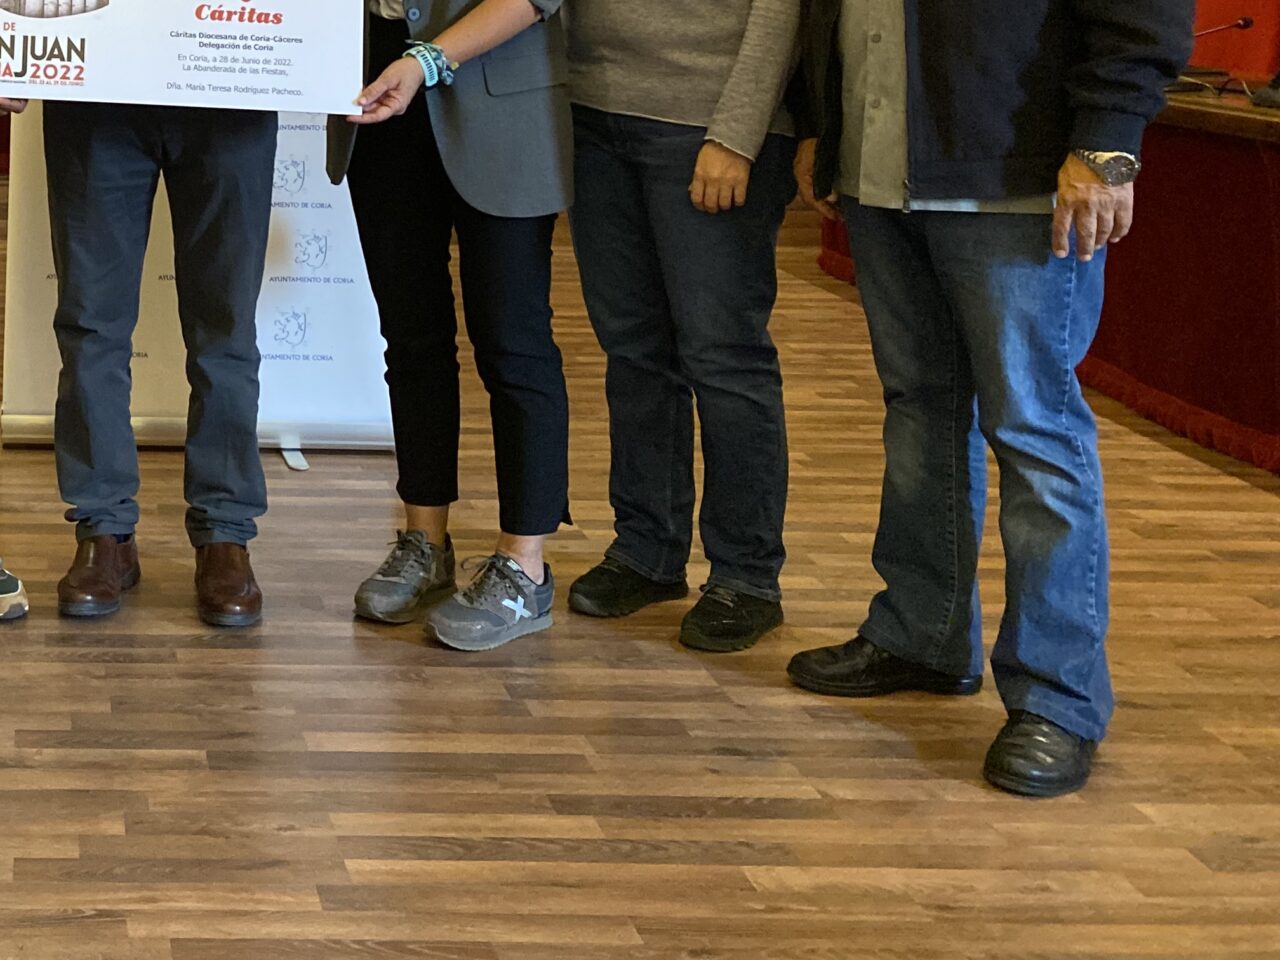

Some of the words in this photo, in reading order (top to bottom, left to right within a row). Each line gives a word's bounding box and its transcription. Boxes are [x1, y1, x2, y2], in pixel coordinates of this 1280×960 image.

[195, 4, 283, 25] Cáritas
[3, 22, 16, 32] DE
[169, 30, 197, 39] Cáritas
[198, 32, 237, 41] Diocesana
[238, 33, 249, 41] de
[250, 34, 303, 43] Coria-Cáceres
[198, 41, 240, 50] Delegación
[253, 43, 274, 51] Coria
[14, 35, 86, 78] JUAN
[177, 53, 187, 61] En
[219, 55, 229, 63] 28
[230, 56, 240, 64] de
[241, 56, 260, 65] Junio
[262, 57, 272, 65] de
[30, 63, 85, 81] 2022
[193, 64, 236, 73] Abanderada
[238, 66, 247, 74] de
[249, 66, 260, 74] las
[207, 84, 232, 93] Teresa
[279, 124, 321, 132] NTAMIENTO
[269, 276, 322, 284] AYUNTAMIENTO
[323, 276, 331, 284] DE
[333, 277, 355, 285] CORIA
[261, 353, 301, 361] NTAMIENTO
[302, 353, 310, 361] DE
